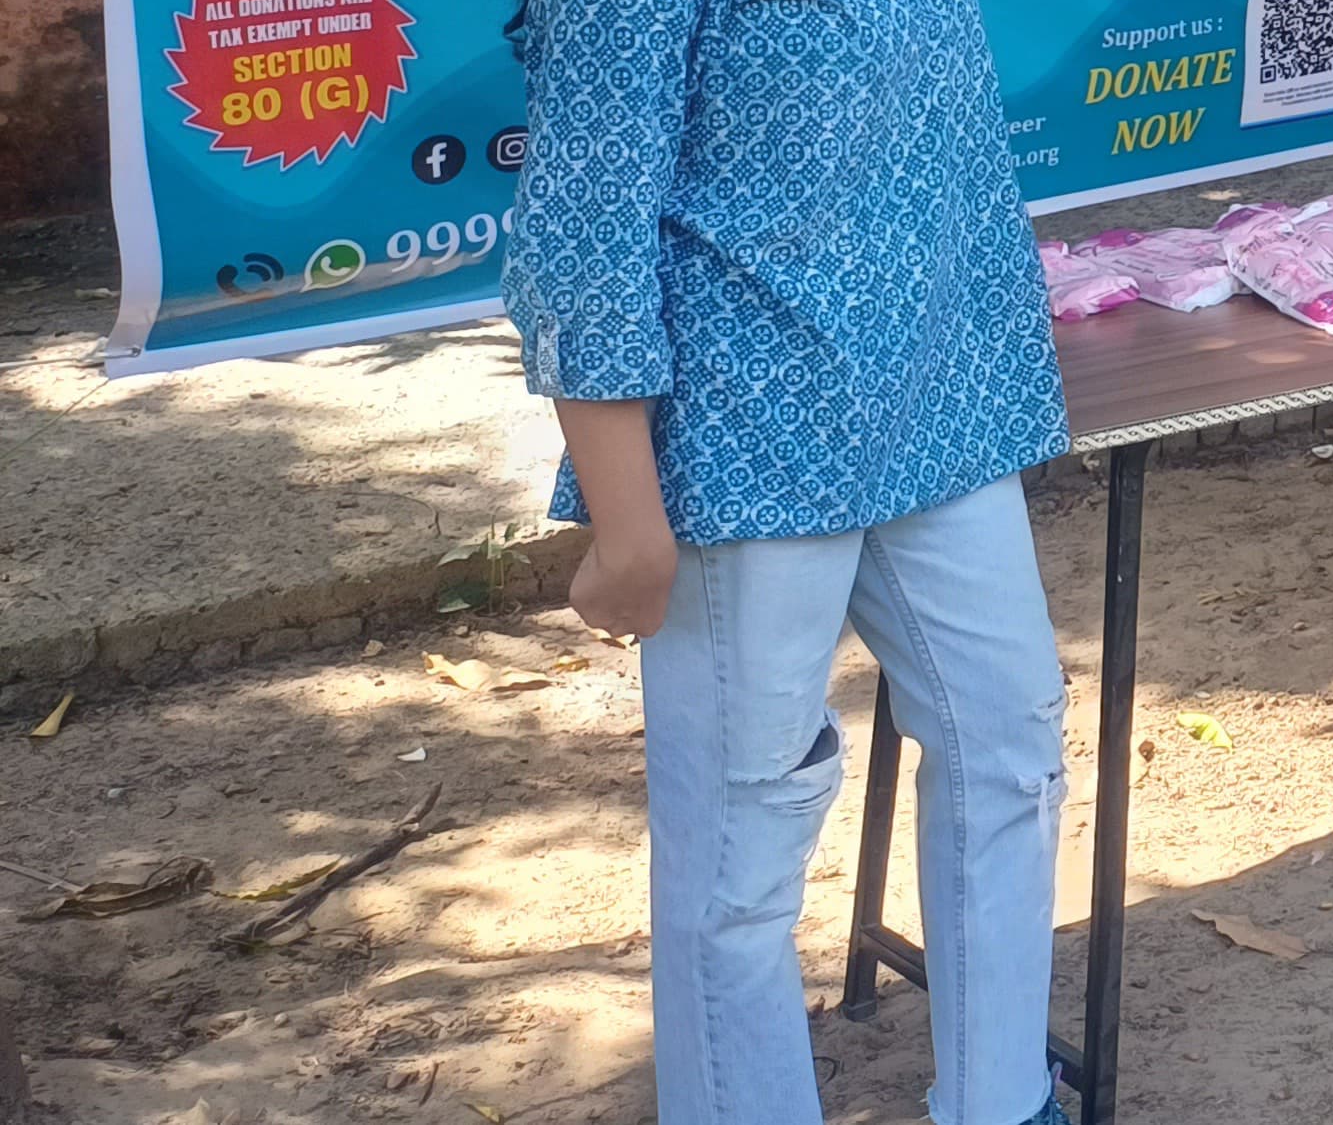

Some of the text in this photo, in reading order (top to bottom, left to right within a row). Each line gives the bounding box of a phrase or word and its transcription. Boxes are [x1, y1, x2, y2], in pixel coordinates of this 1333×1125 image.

[205, 1, 234, 22] ALL
[208, 12, 372, 49] TAX EXEMPT UNDER
[1101, 19, 1187, 50] Support
[1191, 17, 1213, 36] us
[233, 42, 352, 83] SECTION
[1085, 48, 1236, 105] DONATE
[222, 75, 369, 126] 80 (G)
[1008, 116, 1047, 135] eer
[1111, 107, 1206, 155] NOW
[1010, 146, 1060, 167] n.org
